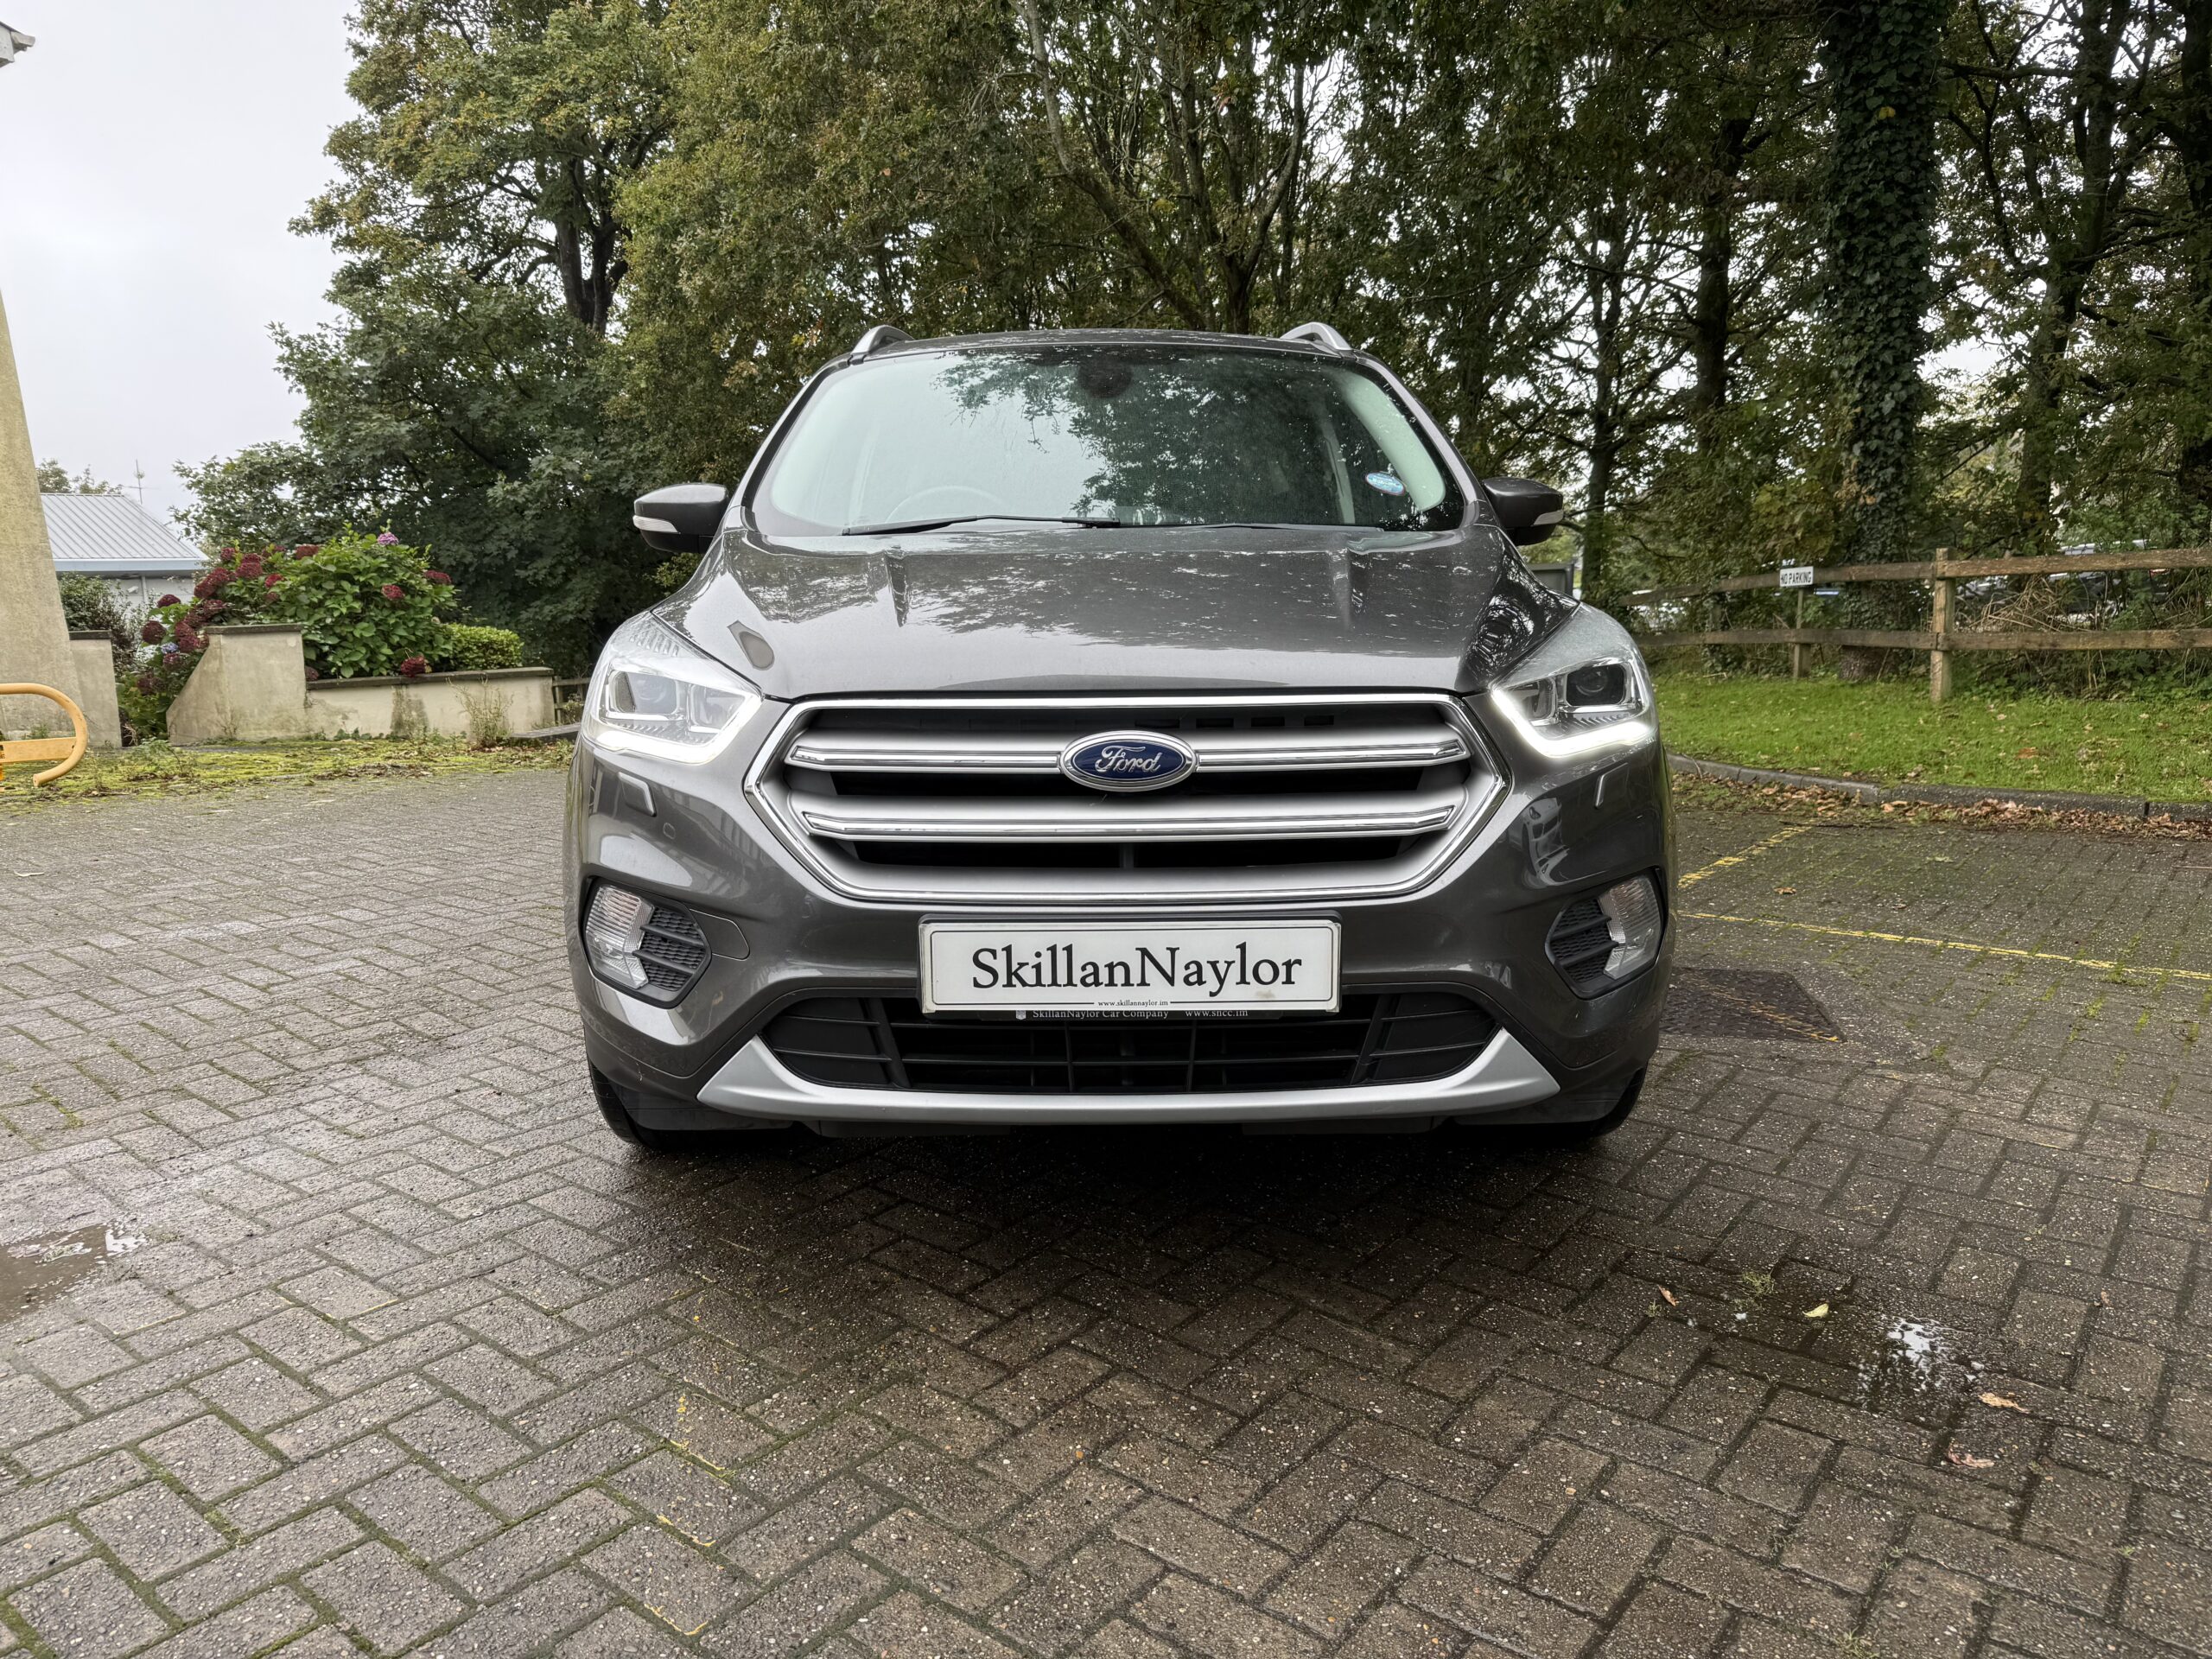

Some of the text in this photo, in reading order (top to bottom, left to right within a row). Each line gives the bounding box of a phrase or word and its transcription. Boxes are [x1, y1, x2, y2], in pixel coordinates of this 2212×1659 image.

[1789, 571, 1811, 584] PARKING
[1095, 746, 1163, 772] Ford
[972, 942, 1302, 997] SkillanNaylor
[1098, 999, 1168, 1007] www.skillannaylor.im
[1122, 1010, 1169, 1019] Company
